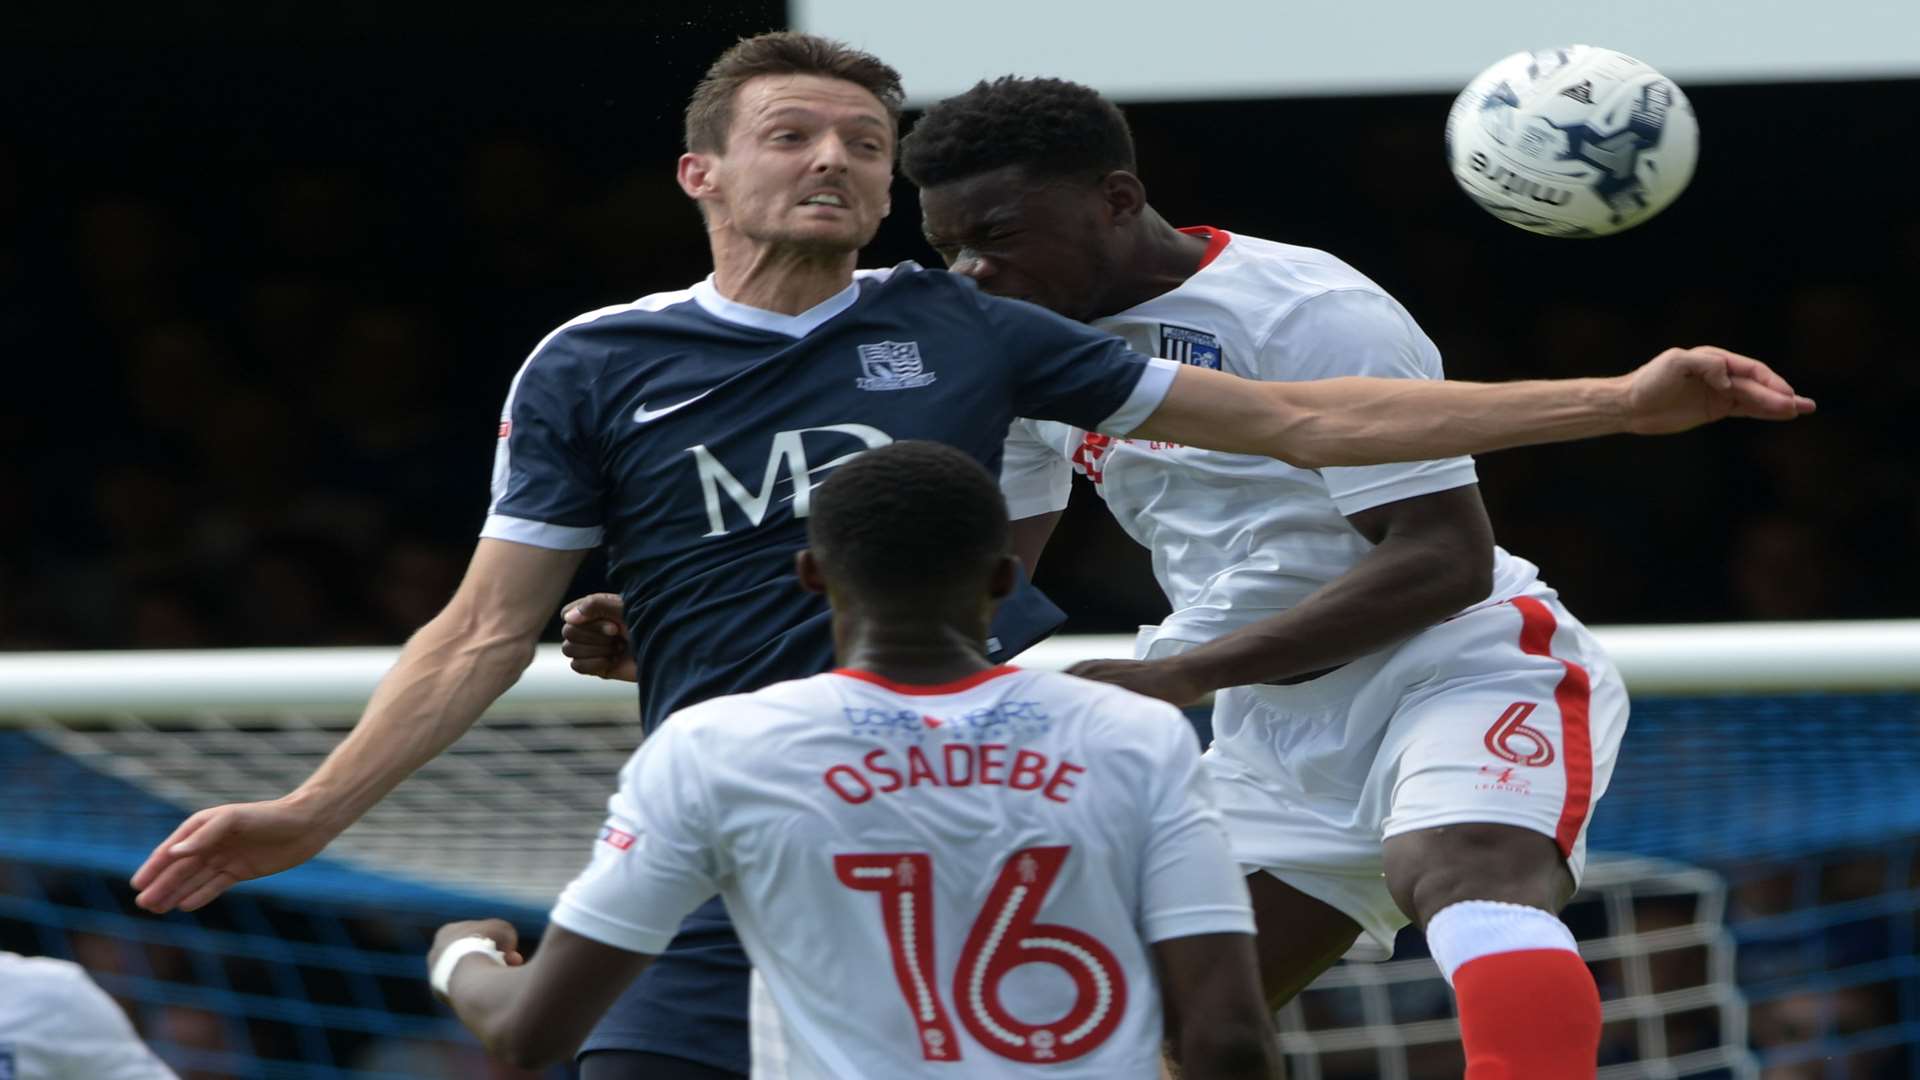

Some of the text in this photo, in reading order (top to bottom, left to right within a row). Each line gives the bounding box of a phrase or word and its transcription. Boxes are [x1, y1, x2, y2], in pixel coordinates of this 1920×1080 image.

[1484, 701, 1555, 768] 6
[823, 743, 1087, 805] OSADEBE
[833, 845, 1129, 1064] 16
